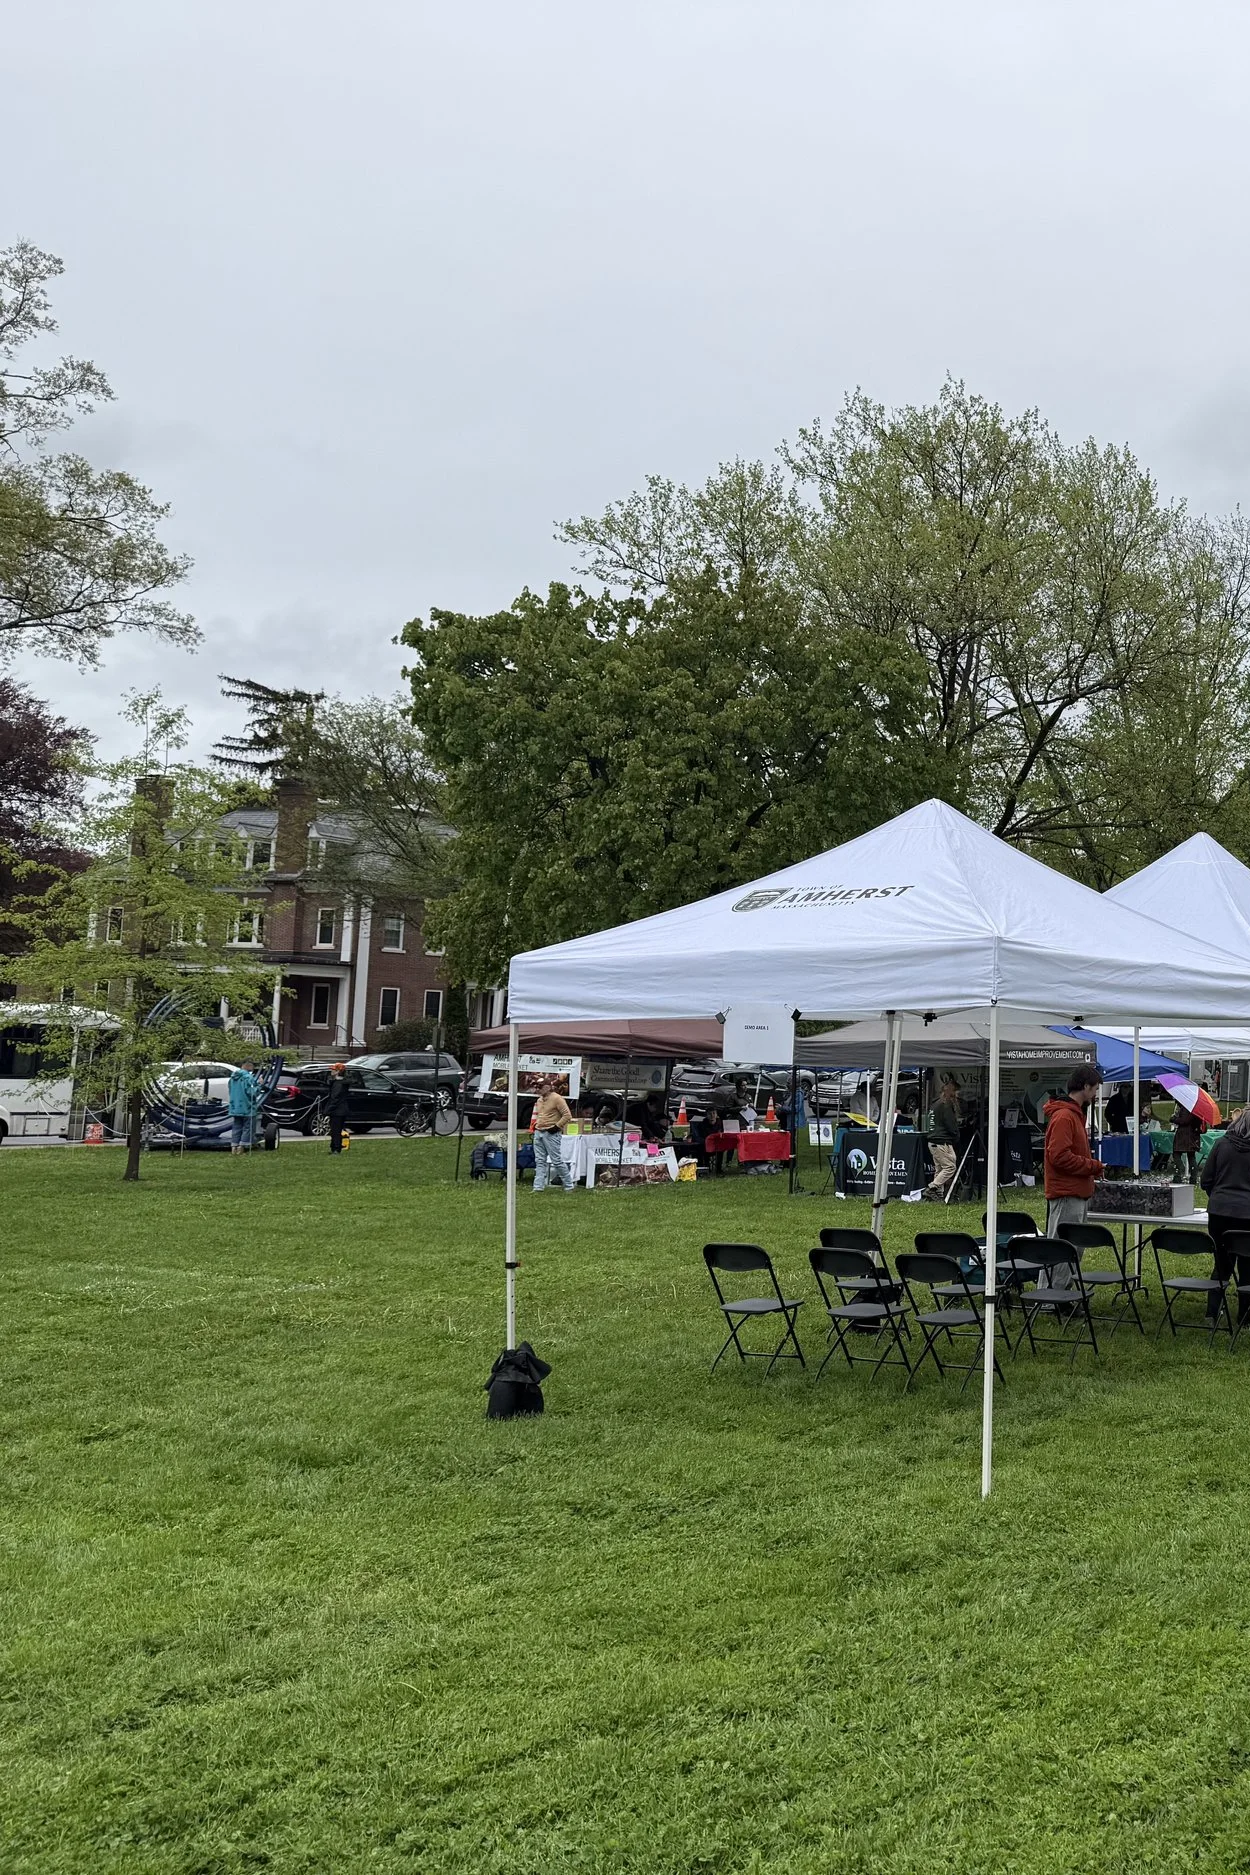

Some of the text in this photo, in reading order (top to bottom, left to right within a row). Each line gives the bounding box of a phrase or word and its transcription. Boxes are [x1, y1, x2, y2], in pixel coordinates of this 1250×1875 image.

[777, 885, 916, 904] AMHERST
[1006, 1049, 1084, 1059] VISTAHOMEIMPROVEMENT.COM
[594, 1148, 620, 1157] AMHERS
